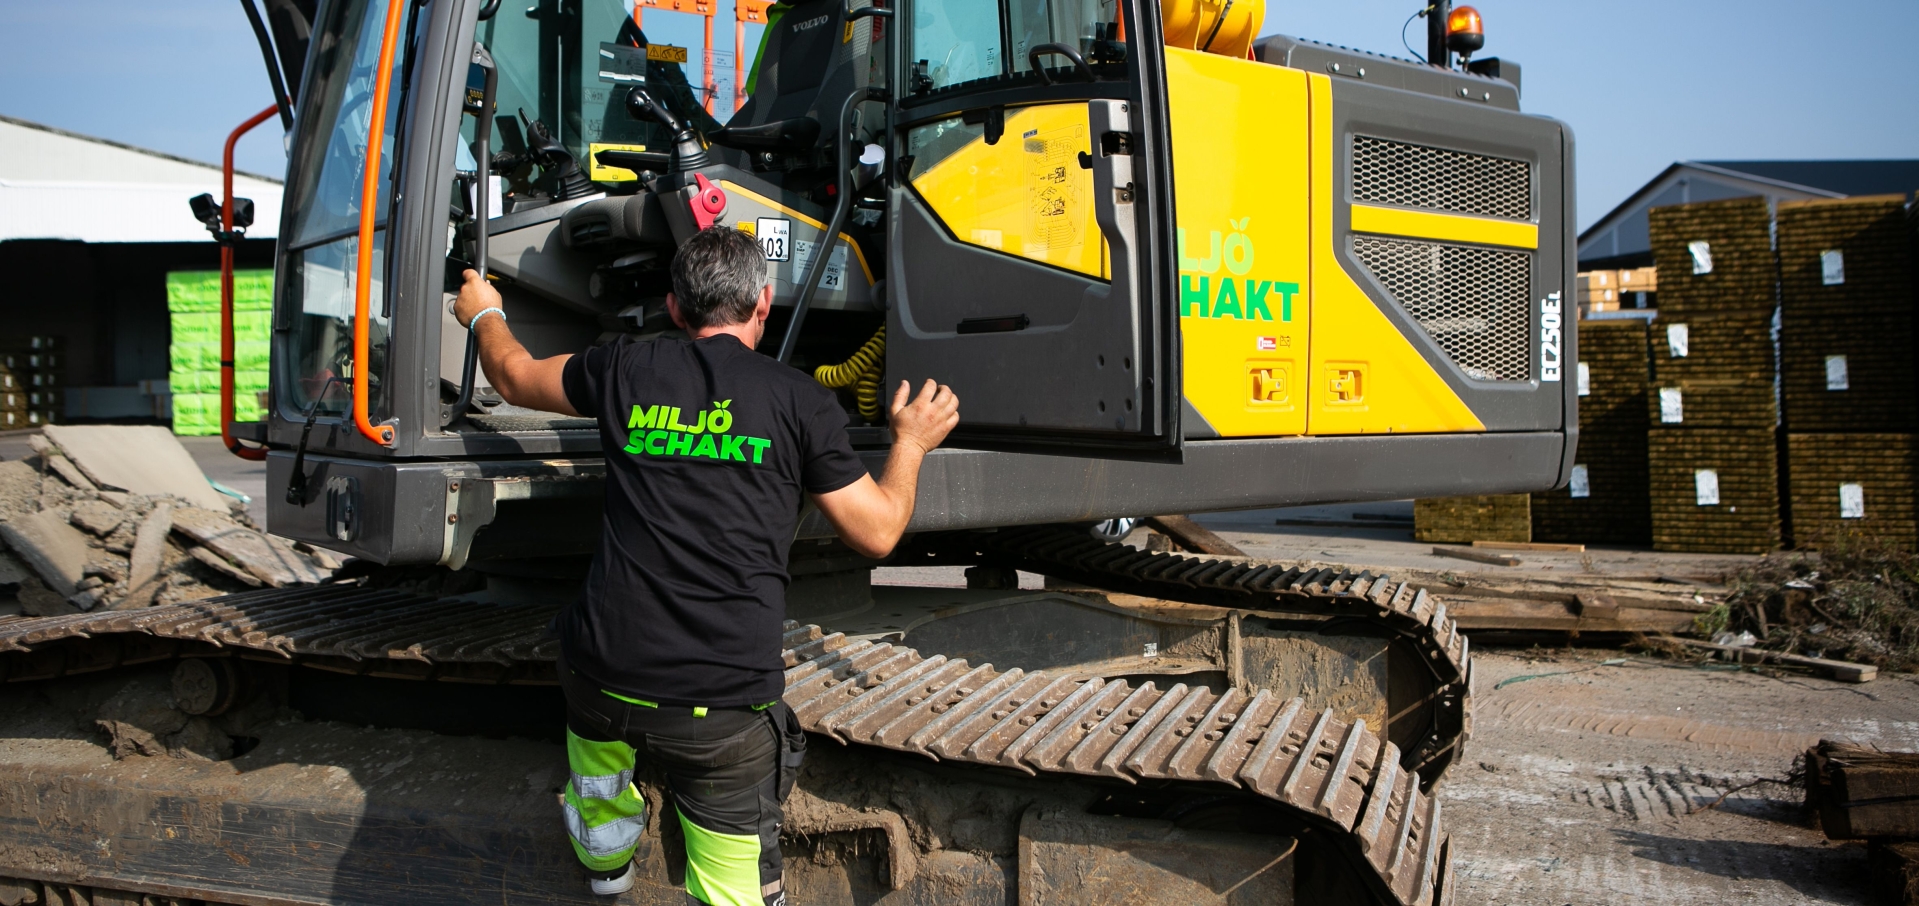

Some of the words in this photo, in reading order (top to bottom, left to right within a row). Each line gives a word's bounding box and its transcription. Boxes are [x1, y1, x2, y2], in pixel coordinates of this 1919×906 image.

[793, 15, 829, 33] VOLVO
[1177, 217, 1254, 275] LJÖ
[825, 275, 838, 286] 21
[1179, 274, 1299, 322] HAKT
[627, 399, 733, 434] MILJÖ
[623, 429, 772, 464] SCHAKT
